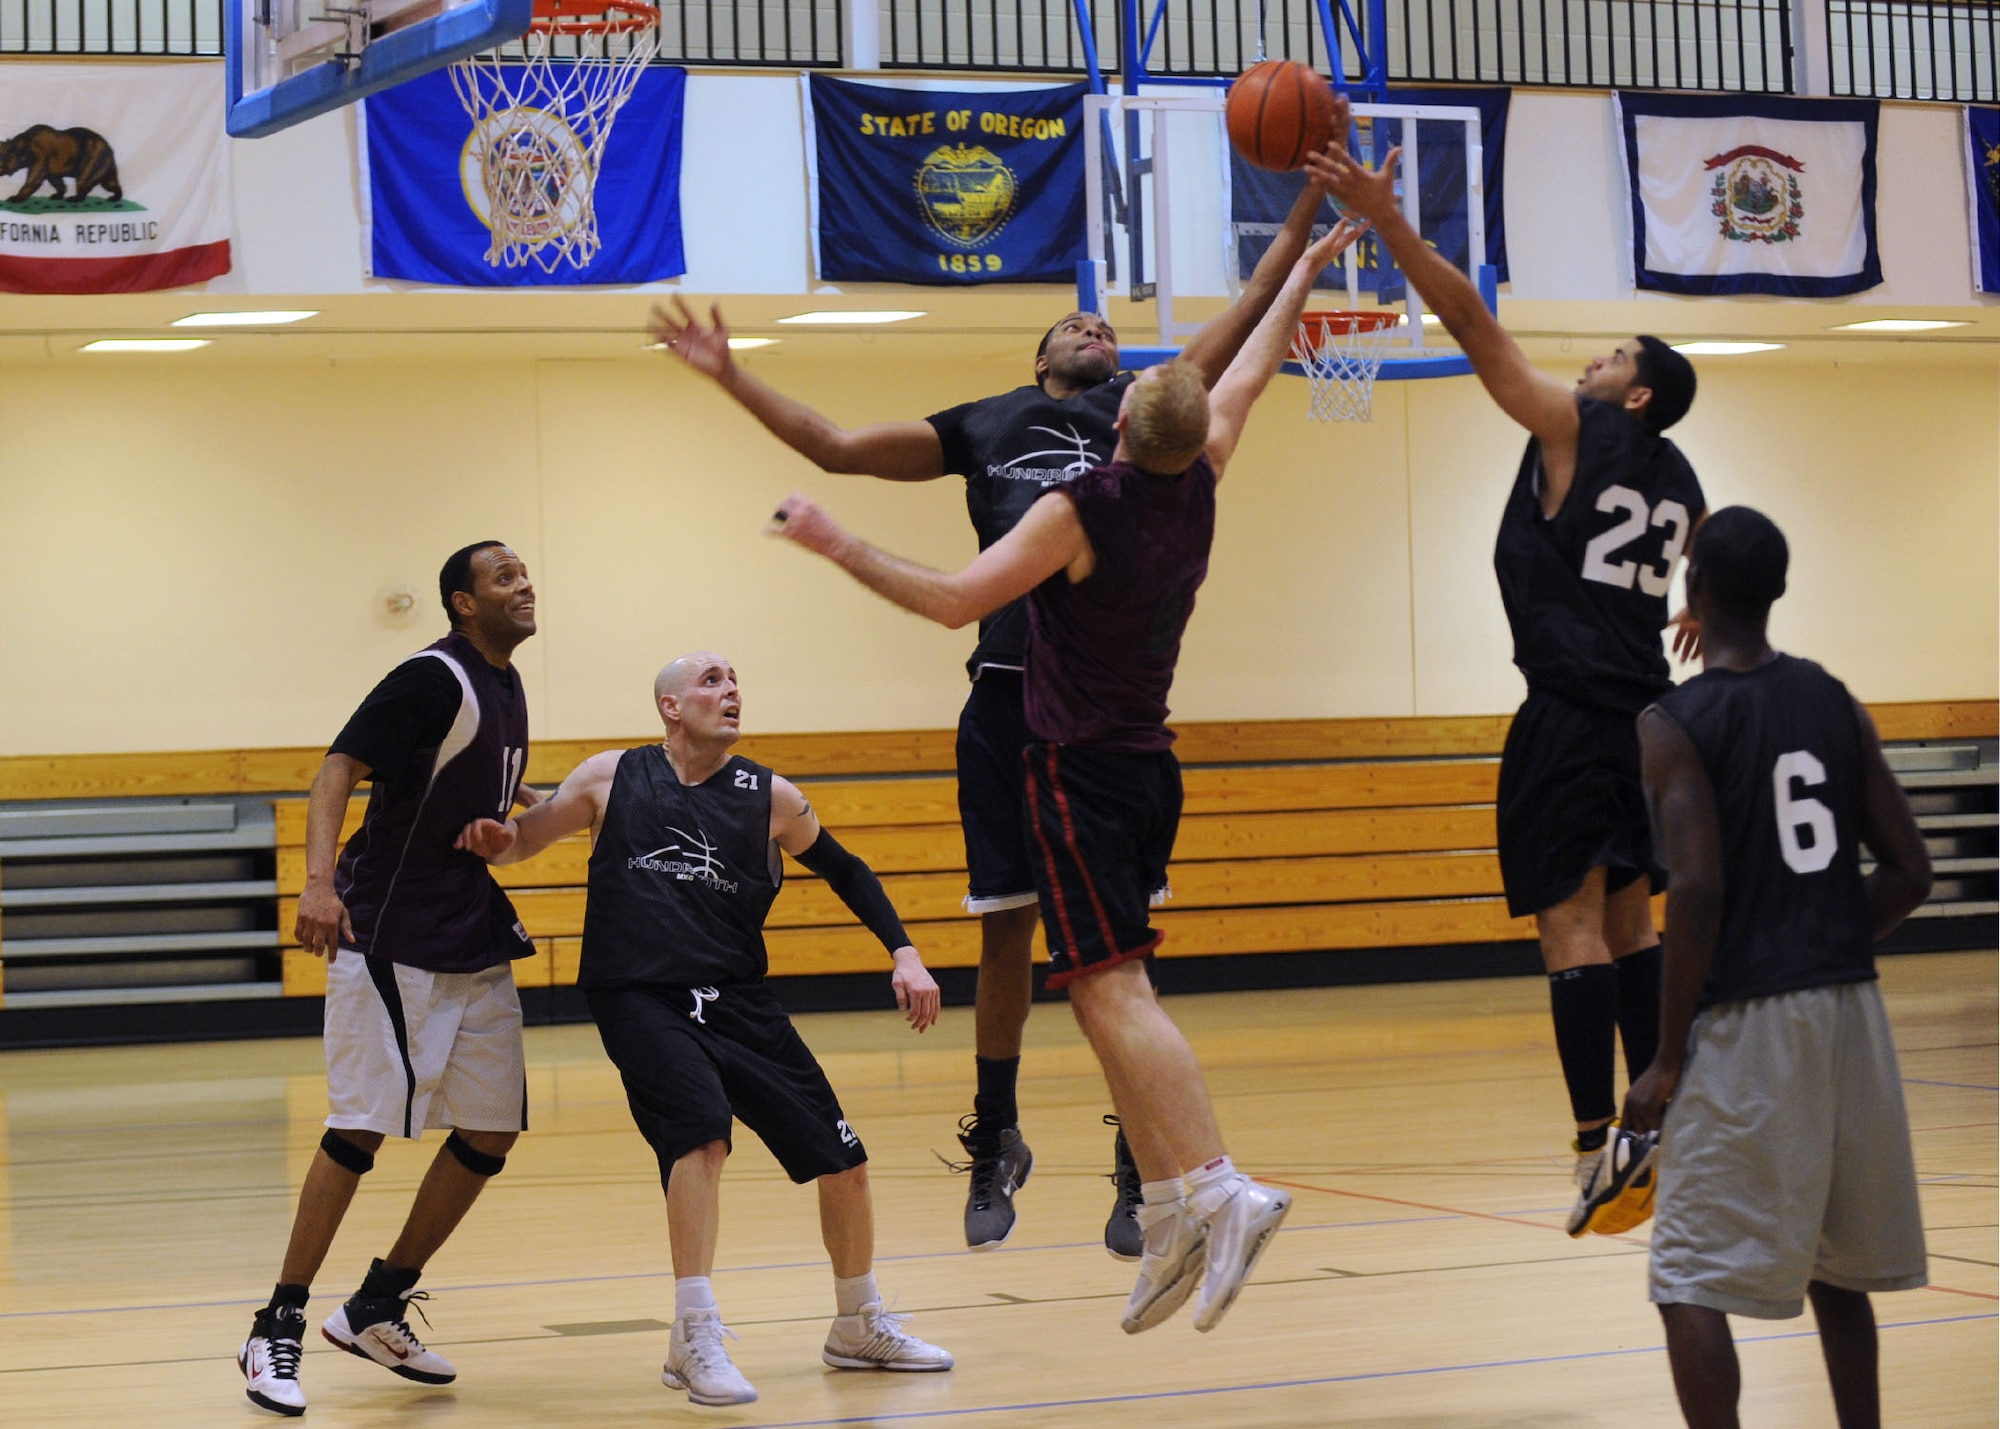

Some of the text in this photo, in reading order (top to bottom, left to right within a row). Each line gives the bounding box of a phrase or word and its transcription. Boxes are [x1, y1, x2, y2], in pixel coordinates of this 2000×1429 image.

[860, 110, 1066, 140] STATE OF OREGON
[76, 221, 158, 244] REPUBLIC
[939, 253, 1003, 273] 1859
[1581, 484, 1690, 598] 23
[498, 746, 523, 812] 11
[733, 768, 759, 790] 21
[1773, 750, 1838, 874] 6
